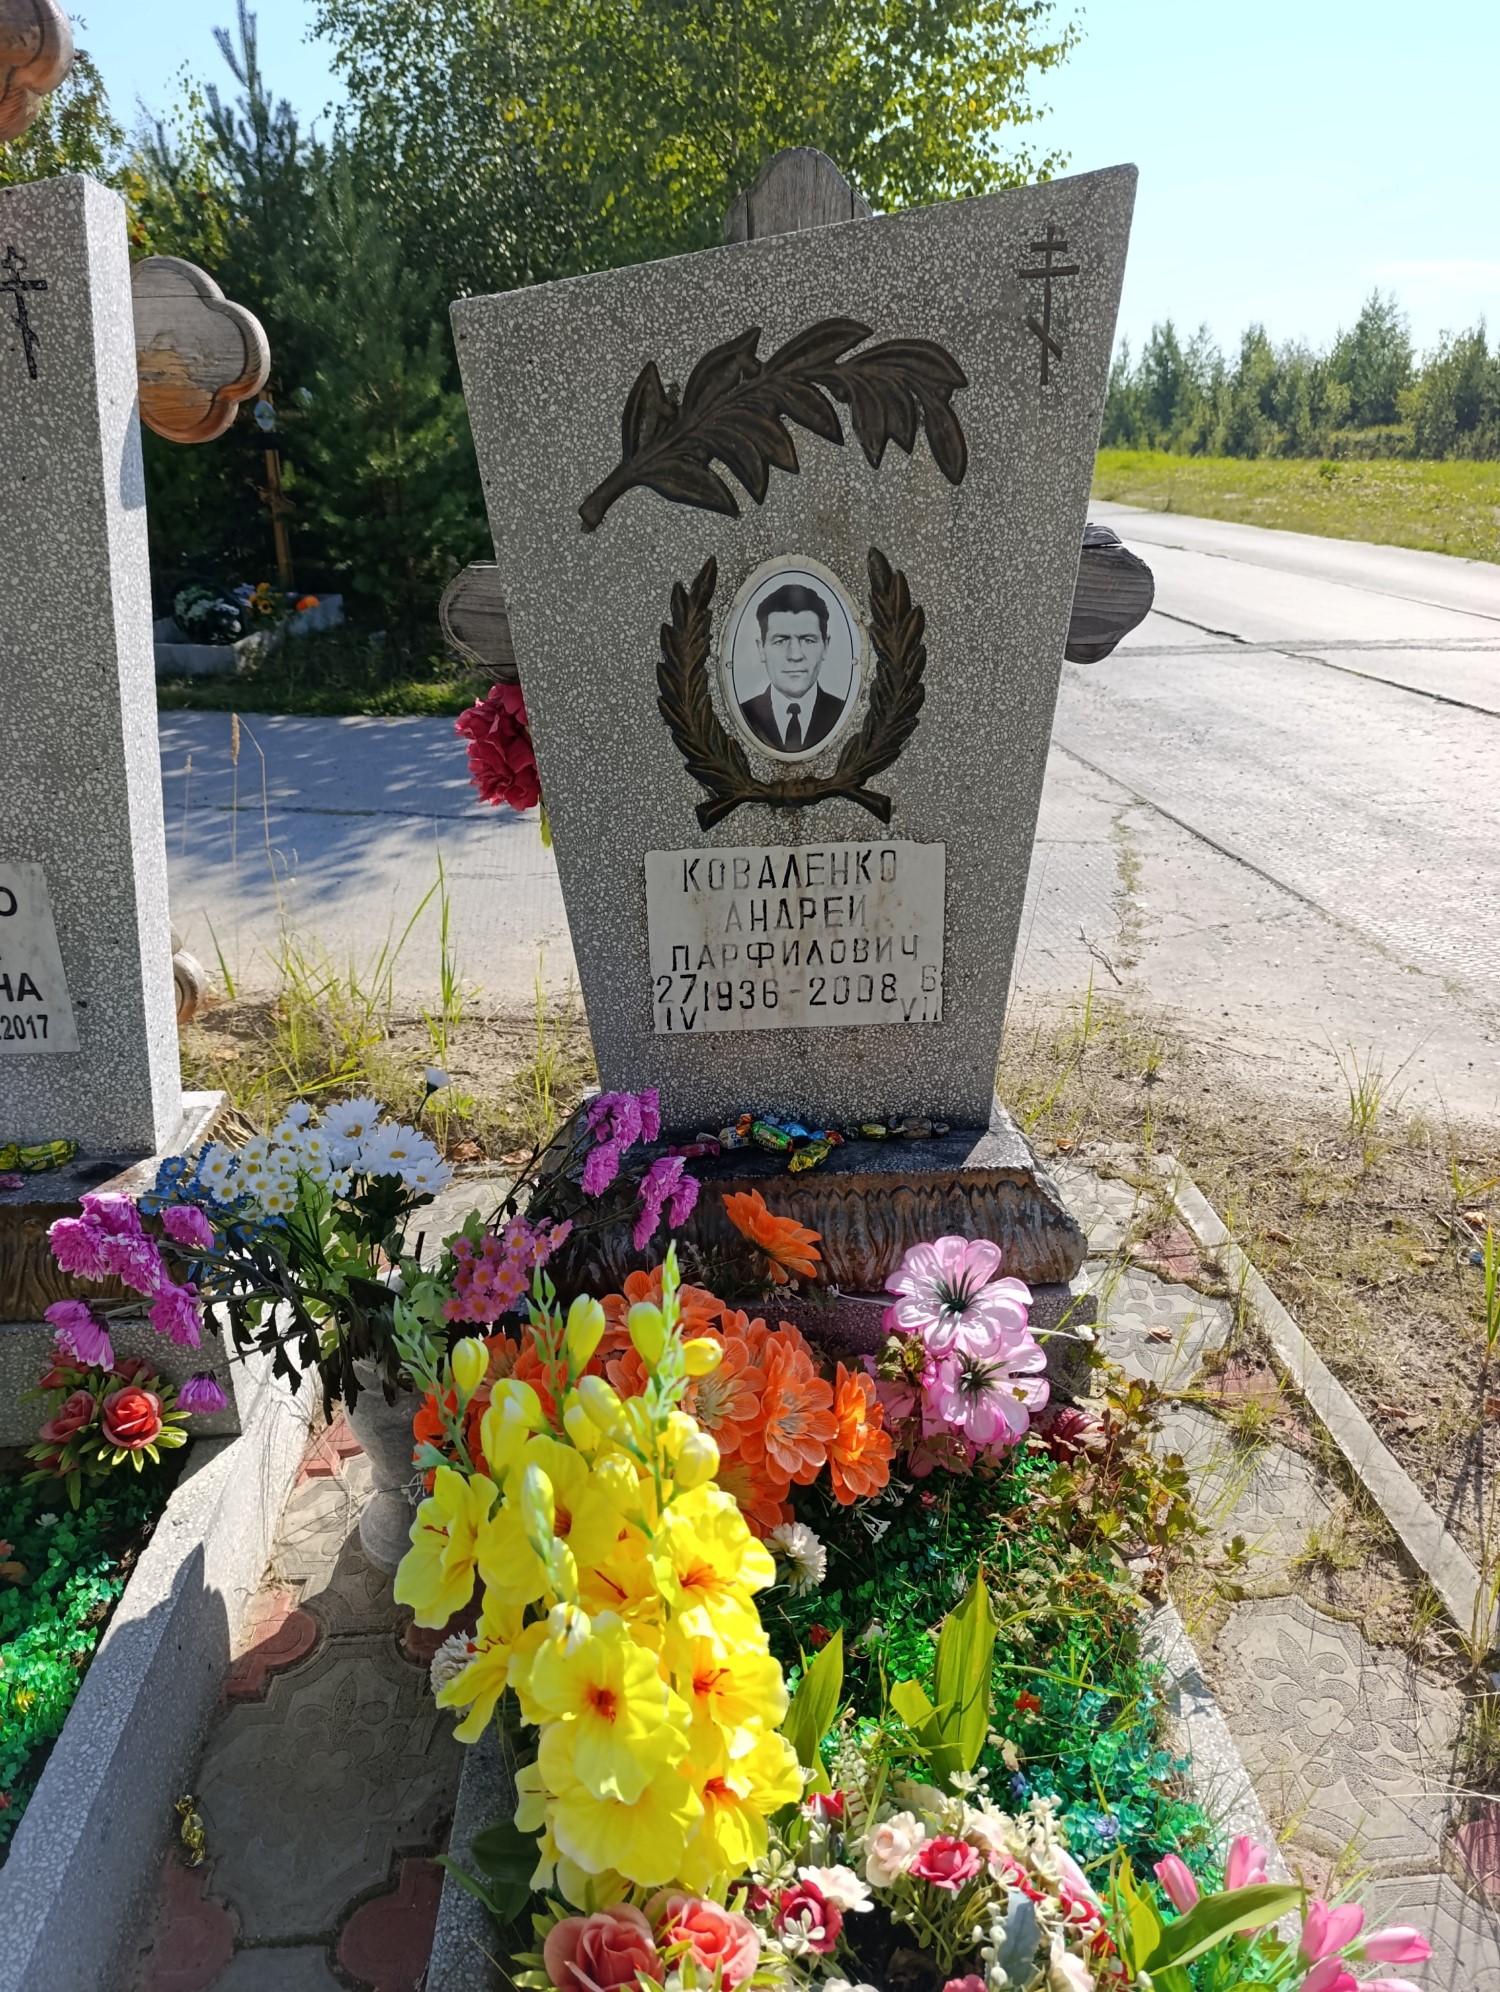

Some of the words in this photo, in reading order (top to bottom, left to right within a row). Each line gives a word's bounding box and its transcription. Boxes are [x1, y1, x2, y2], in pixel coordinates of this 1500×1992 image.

[683, 849, 897, 892] КОВАЛЕНКО
[671, 934, 919, 972] ПАРФИЛОВИЧ
[656, 974, 697, 1005] 27
